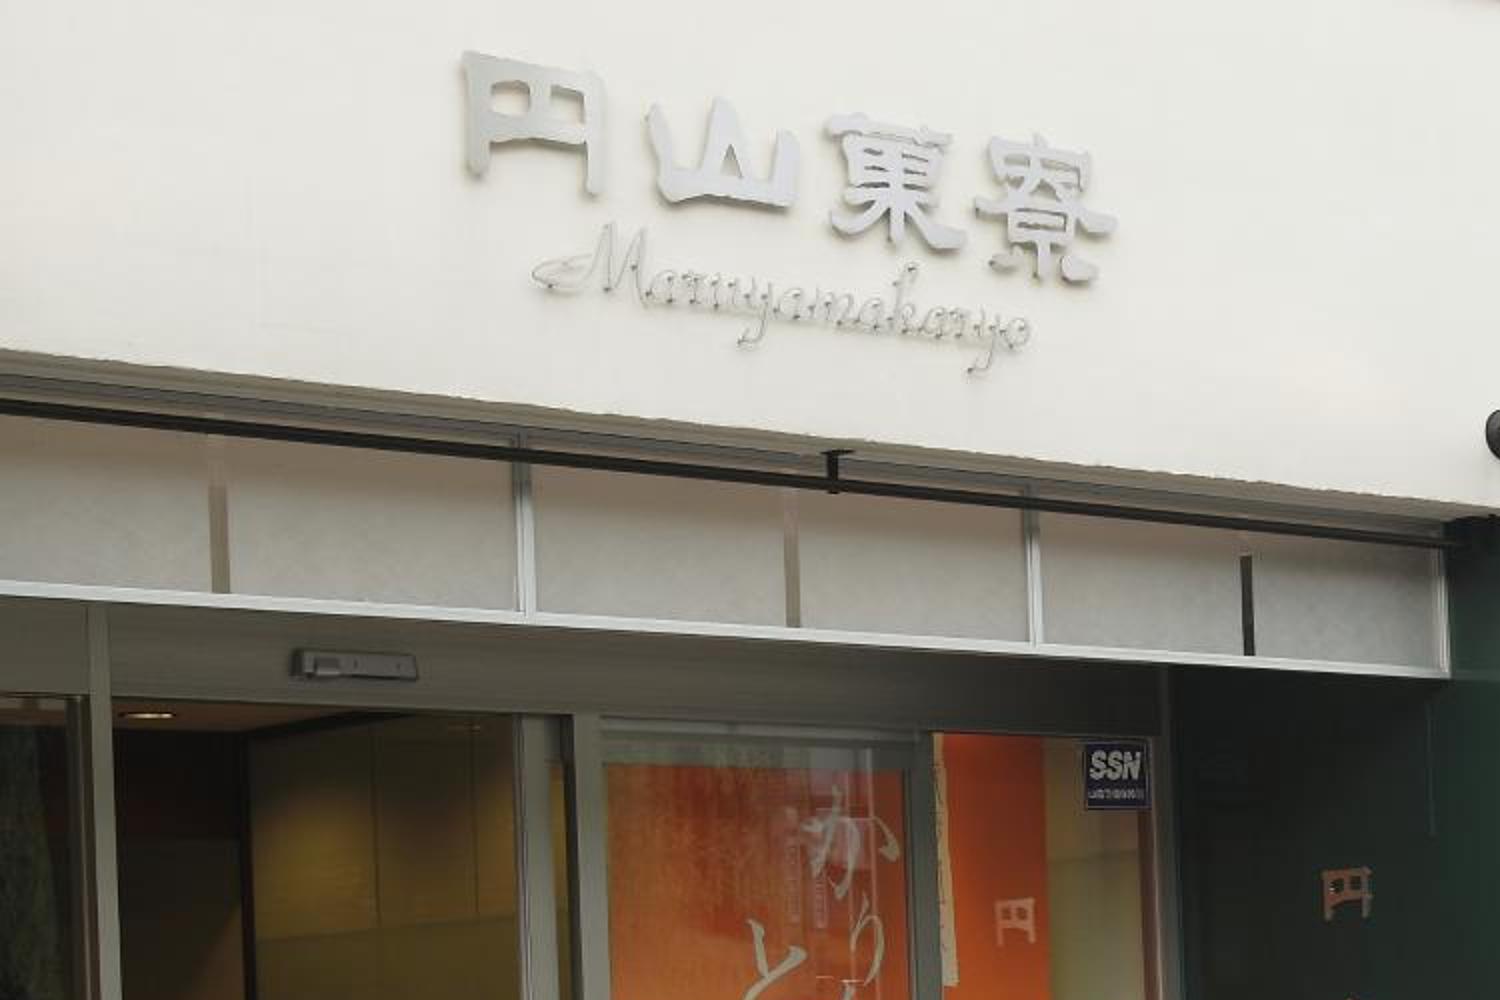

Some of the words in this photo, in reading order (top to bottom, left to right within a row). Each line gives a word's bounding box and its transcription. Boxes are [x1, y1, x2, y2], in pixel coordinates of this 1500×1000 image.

[460, 50, 1118, 285] 円山菓寮
[1089, 750, 1141, 780] SSN
